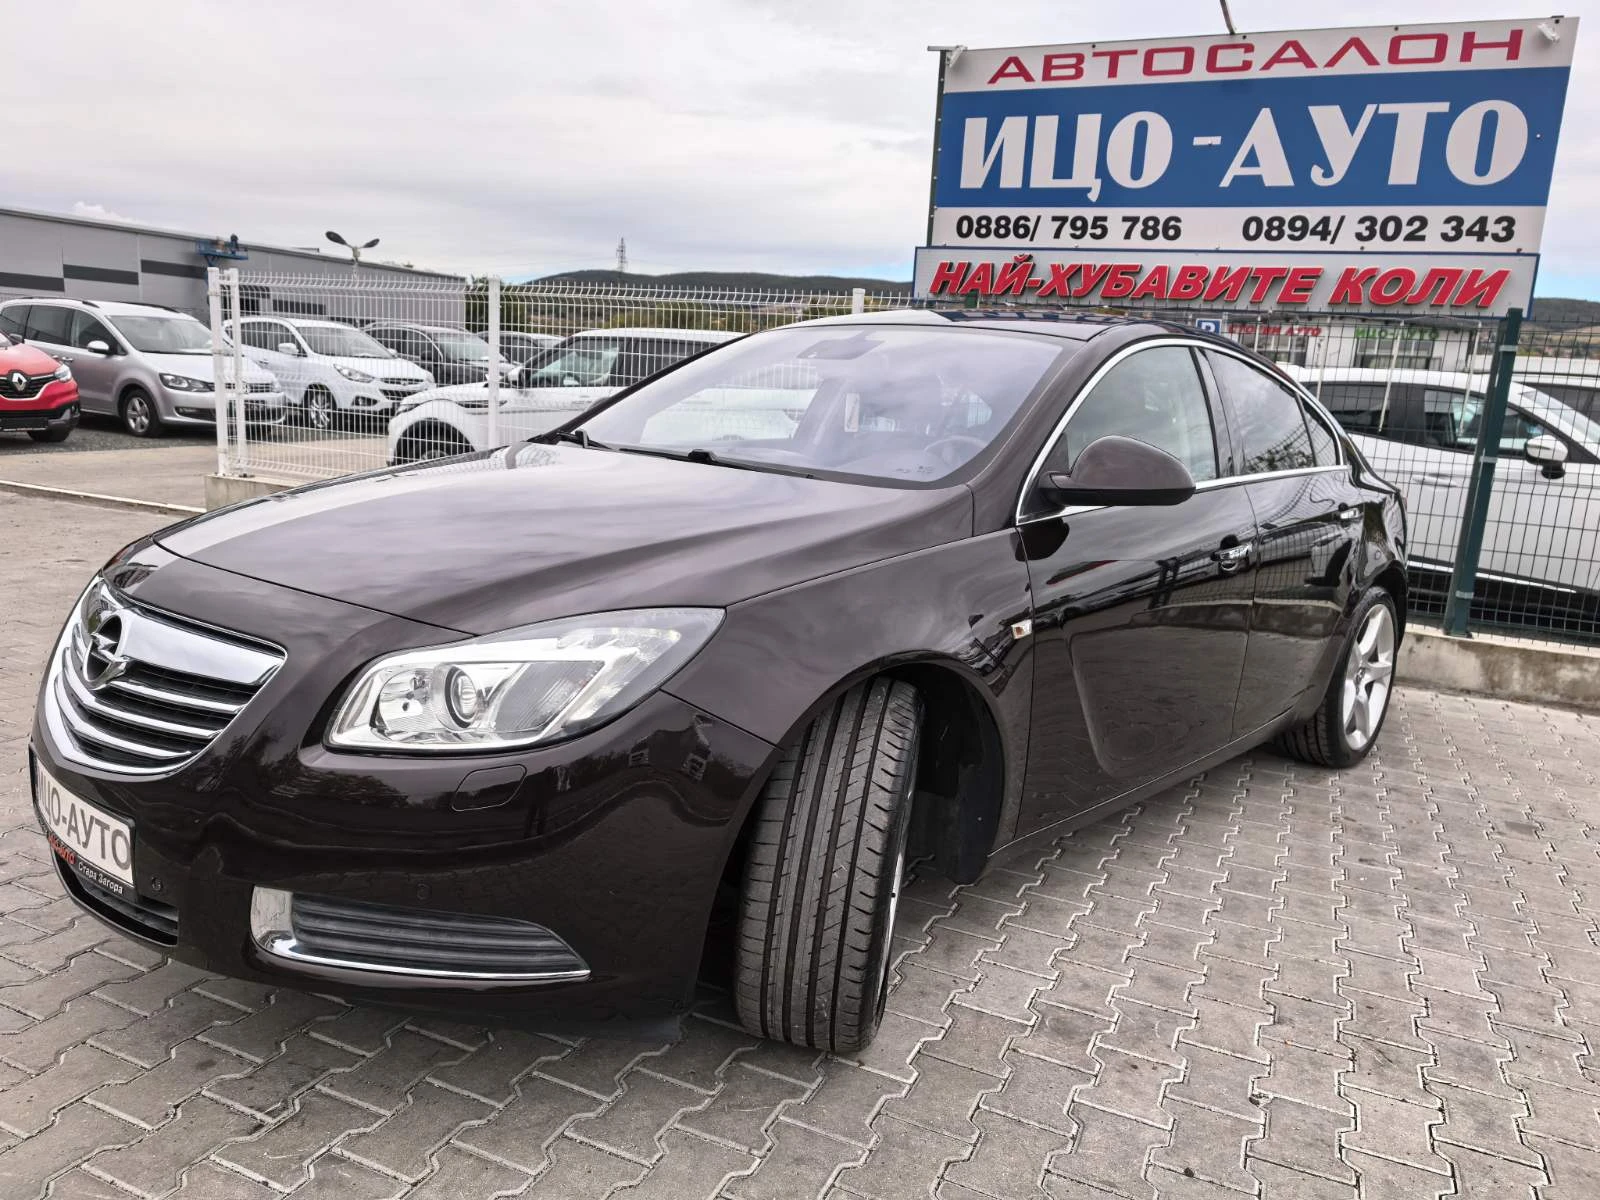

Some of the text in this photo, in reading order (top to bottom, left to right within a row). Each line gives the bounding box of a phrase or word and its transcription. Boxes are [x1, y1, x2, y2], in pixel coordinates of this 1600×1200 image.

[987, 29, 1523, 84] АВТОСАЛОН
[956, 214, 1182, 242] 0886/ 795 786
[1242, 214, 1517, 244] 0894/ 302 343
[929, 253, 1513, 308] НАЙ-ХУБАВИТЕ КОЛИ
[98, 873, 123, 895] Загора
